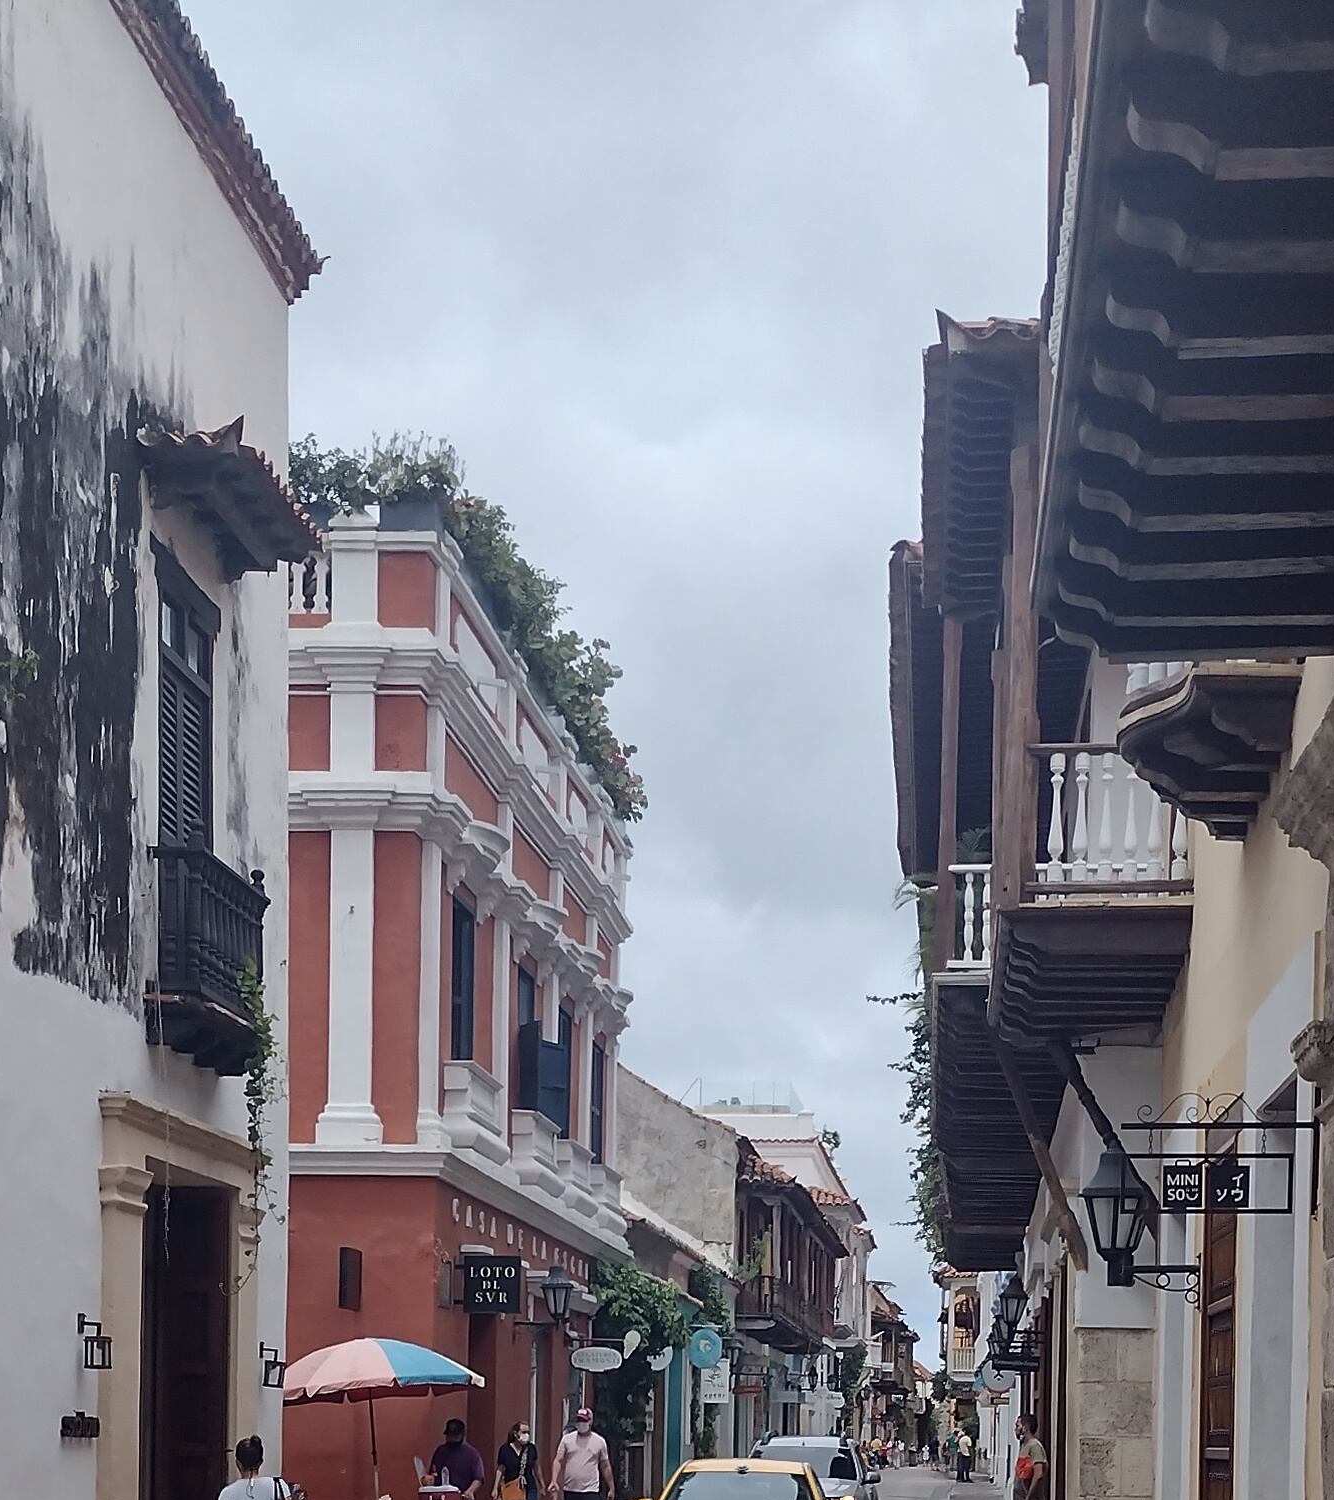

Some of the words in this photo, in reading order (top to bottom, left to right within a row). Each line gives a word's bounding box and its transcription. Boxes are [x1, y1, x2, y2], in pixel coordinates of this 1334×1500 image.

[1167, 1174, 1199, 1186] MINI
[452, 1198, 497, 1239] CASA
[507, 1223, 524, 1251] DE
[532, 1236, 548, 1260] LA
[470, 1266, 515, 1278] LOTO
